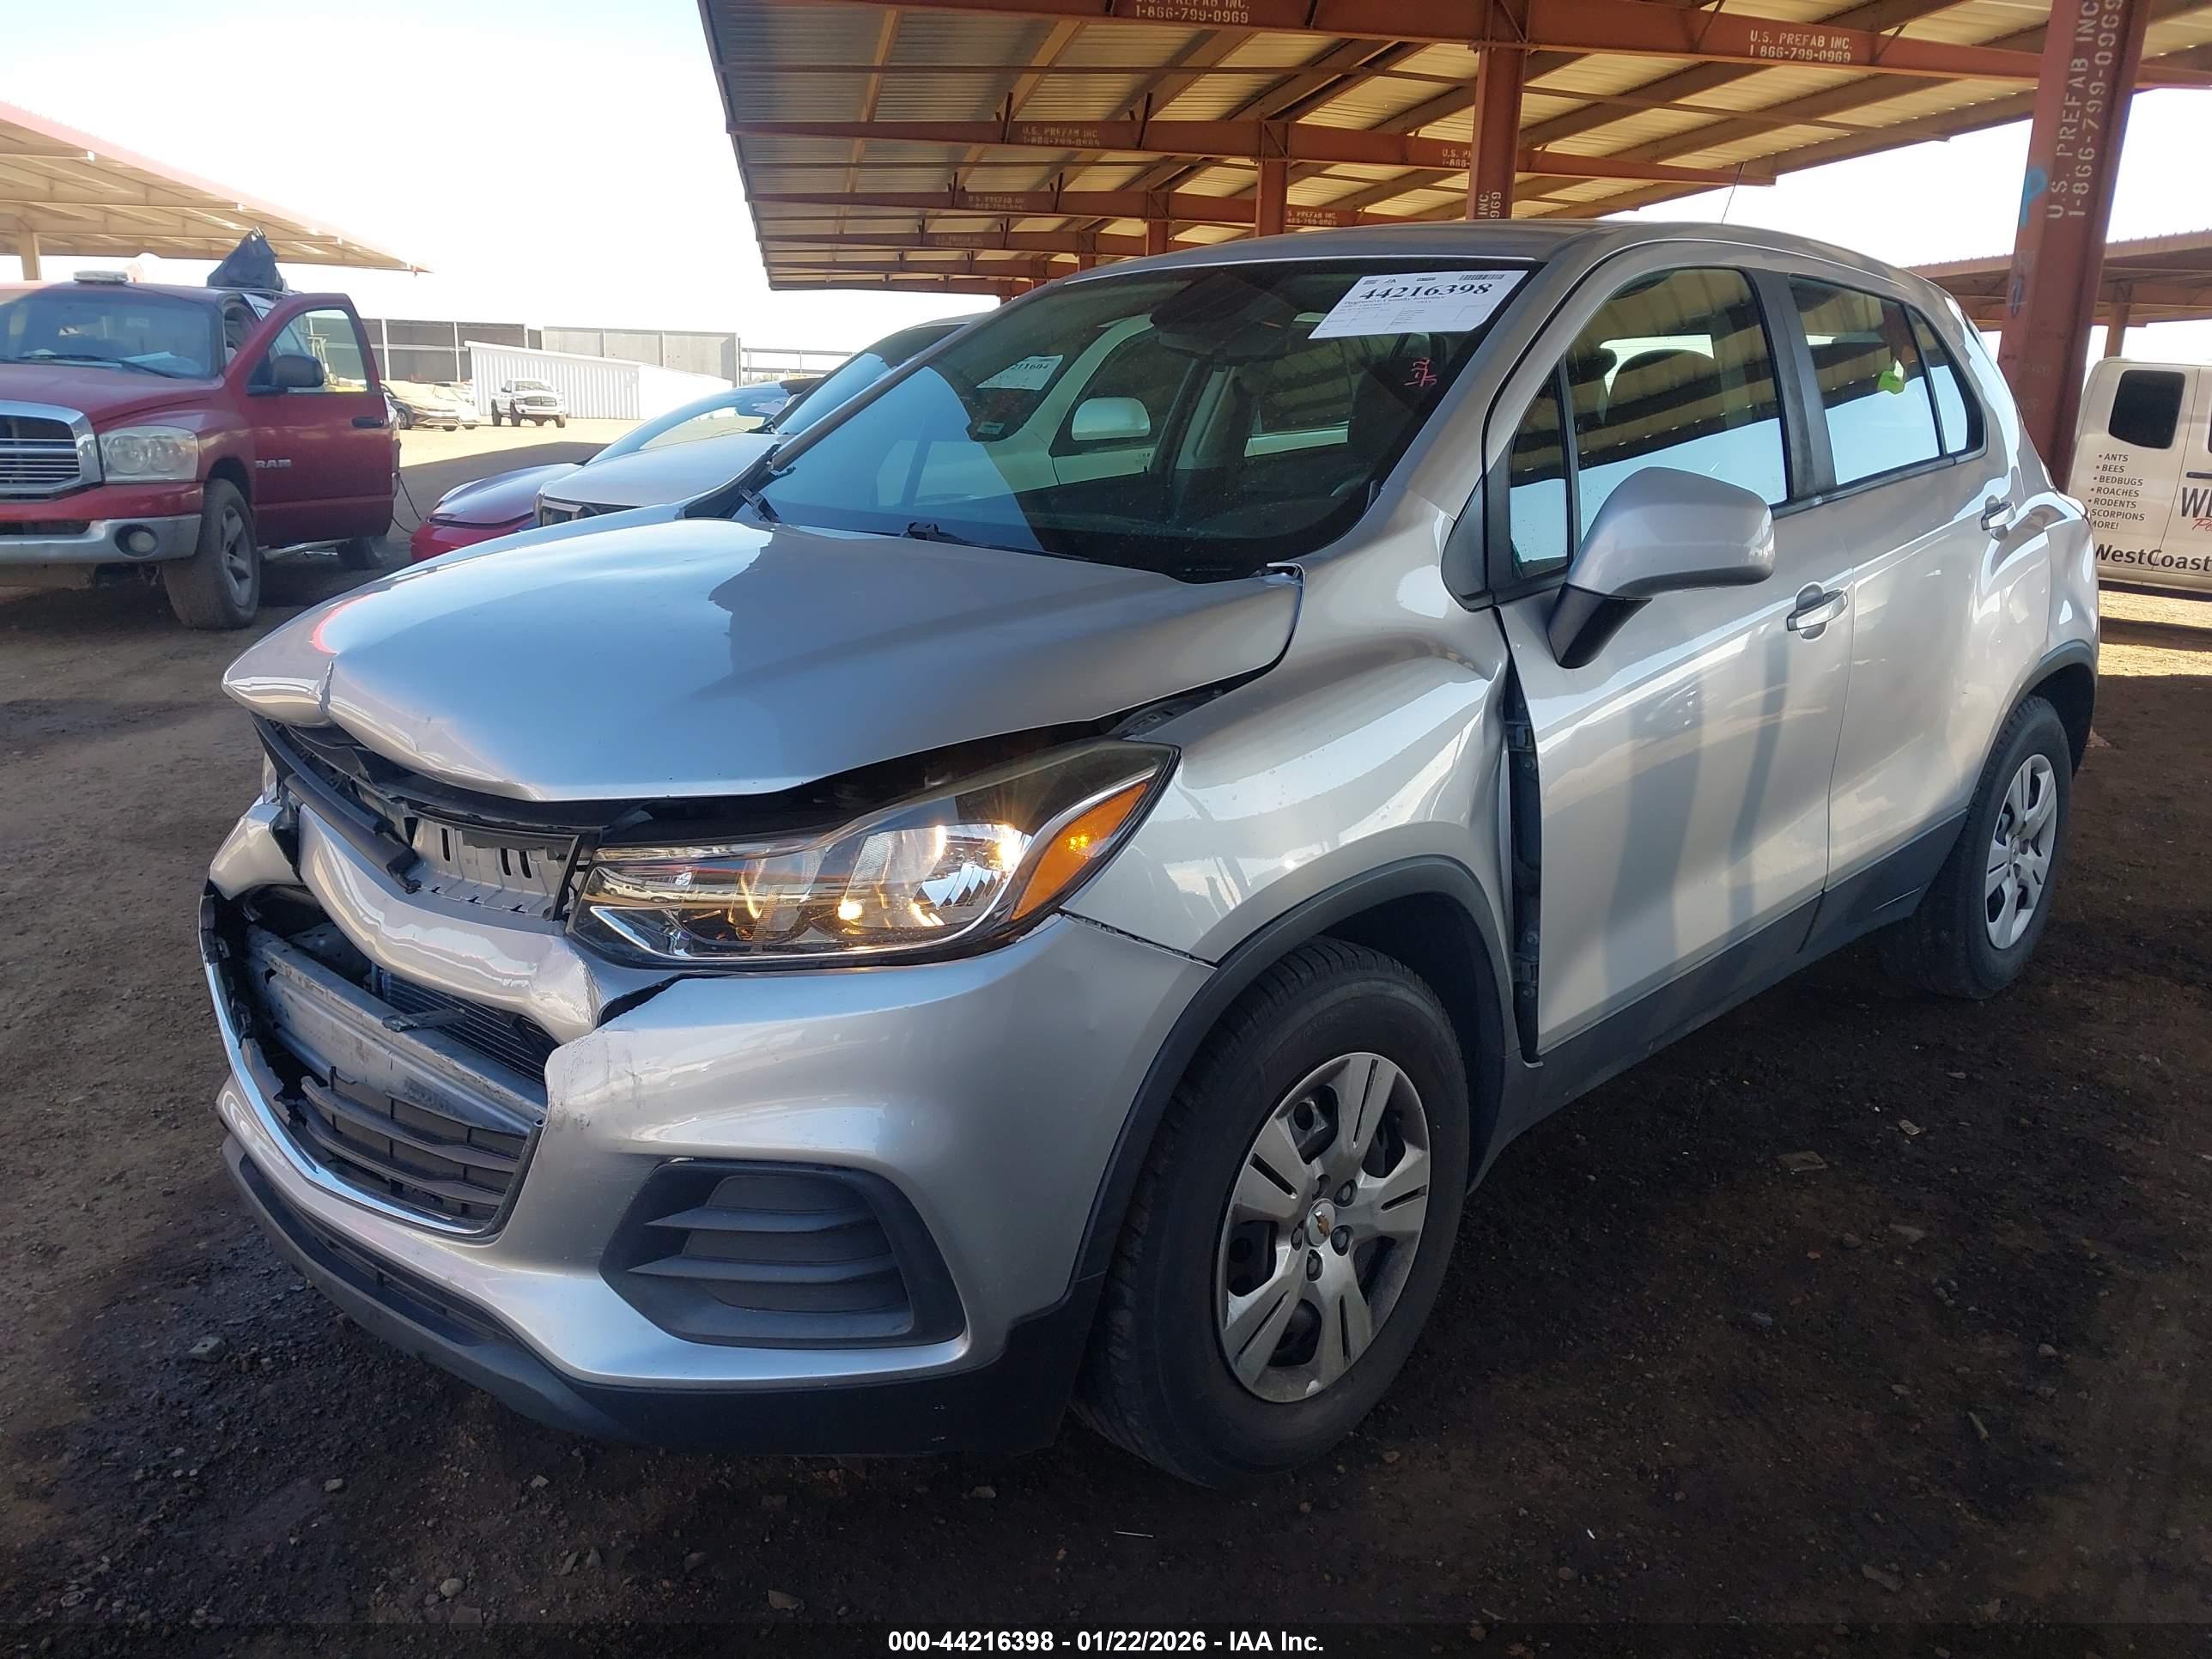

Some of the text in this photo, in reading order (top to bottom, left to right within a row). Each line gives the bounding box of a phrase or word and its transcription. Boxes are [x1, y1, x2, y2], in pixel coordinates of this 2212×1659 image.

[1135, 5, 1249, 23] 1-866-799-0969
[1750, 29, 1852, 50] U.S. PREFAB INC.
[2056, 57, 2088, 157] PREFAB
[1443, 149, 1459, 158] U.S.
[2047, 173, 2070, 219] U.S.
[1478, 191, 1490, 215] INC.
[1359, 283, 1493, 300] 44216398
[2104, 453, 2129, 462] ANTS
[2101, 464, 2125, 473] BEES
[2099, 475, 2143, 487] BEDBUGS
[2096, 486, 2140, 497] ROACHES
[2094, 498, 2136, 508] RODENTS
[2091, 508, 2145, 521] SCORPIONS
